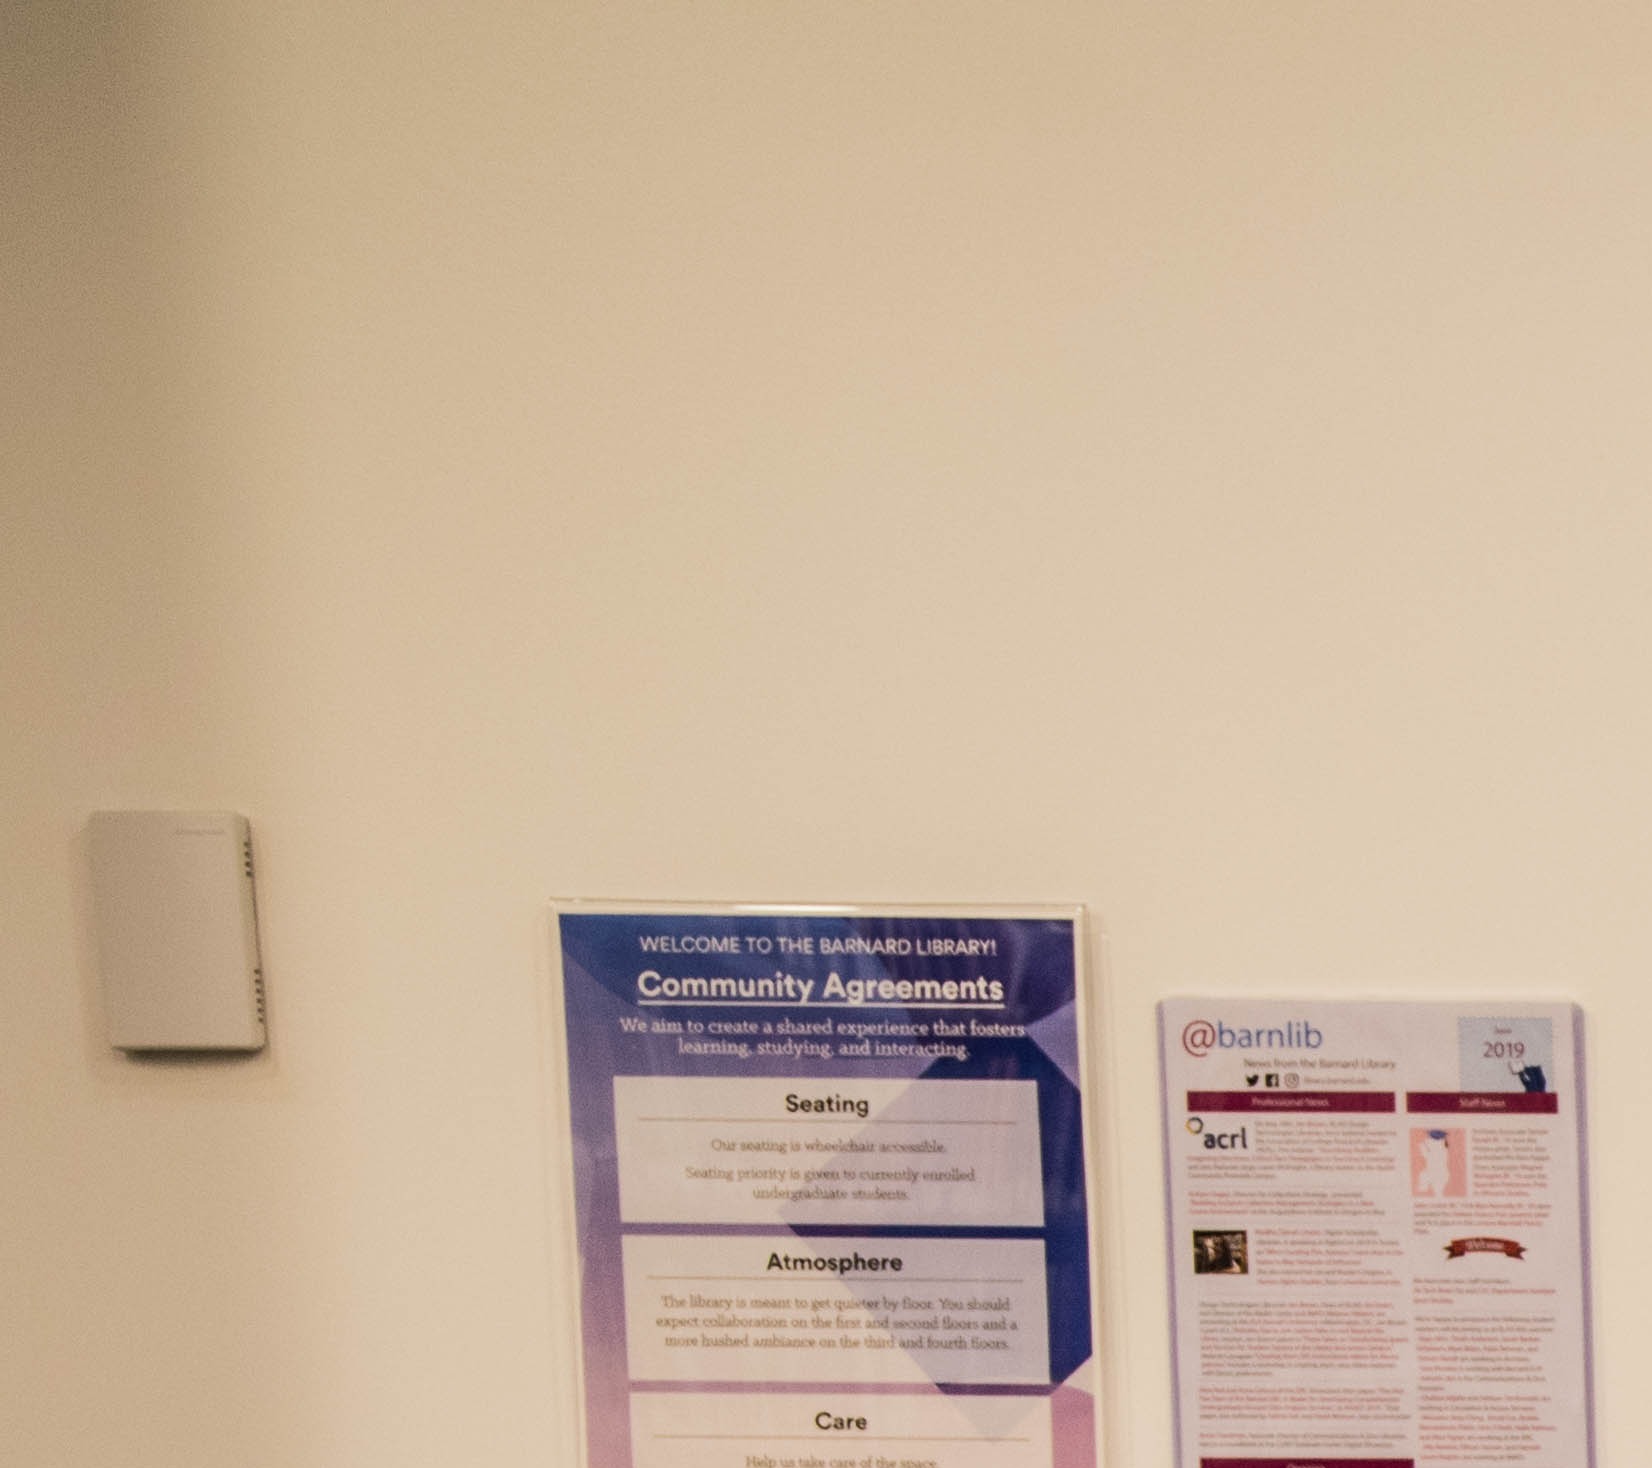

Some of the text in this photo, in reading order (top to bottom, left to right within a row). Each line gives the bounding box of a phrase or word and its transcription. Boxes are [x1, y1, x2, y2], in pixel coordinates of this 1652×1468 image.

[639, 936, 997, 956] WELCOME TO THE BARNARD LIBRARY!
[637, 970, 1004, 1004] Community Agreements
[619, 1016, 1025, 1038] We aim to create a shared experience that fosters
[1182, 1019, 1323, 1058] @barnlib
[678, 1036, 971, 1061] learning, studying, and interacting.
[1483, 1041, 1525, 1059] 2019
[785, 1094, 869, 1118] Seating
[1204, 1127, 1248, 1149] acrl
[767, 1252, 903, 1279] Atmosphere
[815, 1411, 867, 1430] Care
